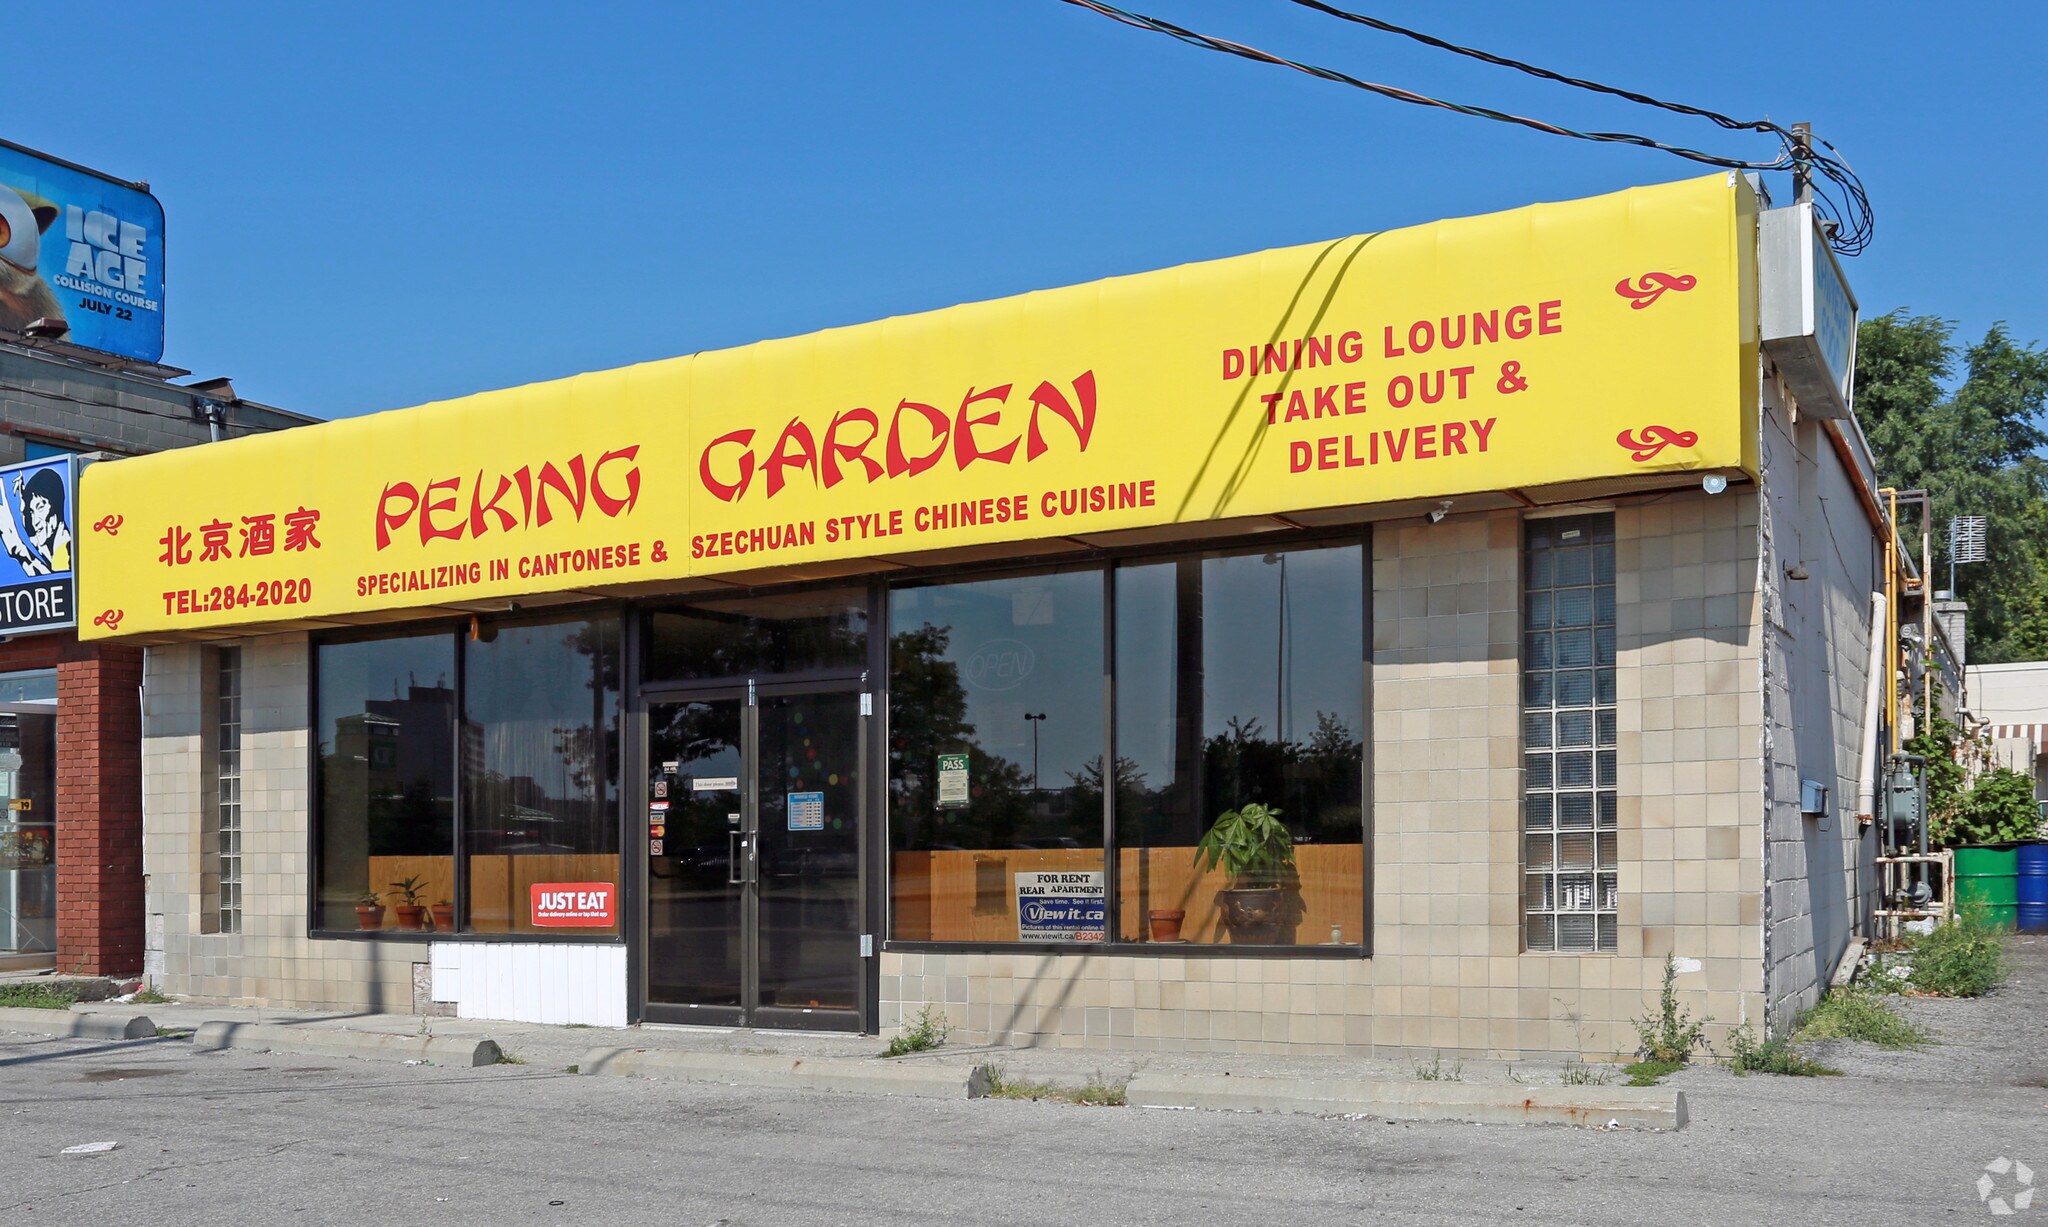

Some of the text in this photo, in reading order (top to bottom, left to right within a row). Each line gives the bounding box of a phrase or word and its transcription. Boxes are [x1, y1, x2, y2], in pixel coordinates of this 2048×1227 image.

[66, 204, 147, 261] ICE
[66, 242, 147, 295] AGE
[53, 274, 158, 311] COLLISION COURSE
[79, 298, 133, 321] JULY 22
[1223, 300, 1562, 380] DINING LOUNGE
[1261, 361, 1528, 425] TAKE OUT &
[376, 370, 1097, 551] PEKING GARDEN
[1290, 418, 1496, 473] DELIVERY
[159, 506, 321, 567] 北京酒家
[357, 480, 1155, 596] SPECIALIZING IN CANTONESE & SZECHUAN STYLE CHINESE CUISINE
[0, 585, 65, 623] TORE
[163, 578, 311, 615] TEL:284-2020
[970, 651, 1028, 679] OPEN
[943, 760, 964, 770] PASS
[21, 801, 30, 809] 19
[1020, 886, 1104, 895] REAR APARTMENT
[1037, 874, 1090, 883] FOR RENT
[538, 892, 607, 910] JUST EAT
